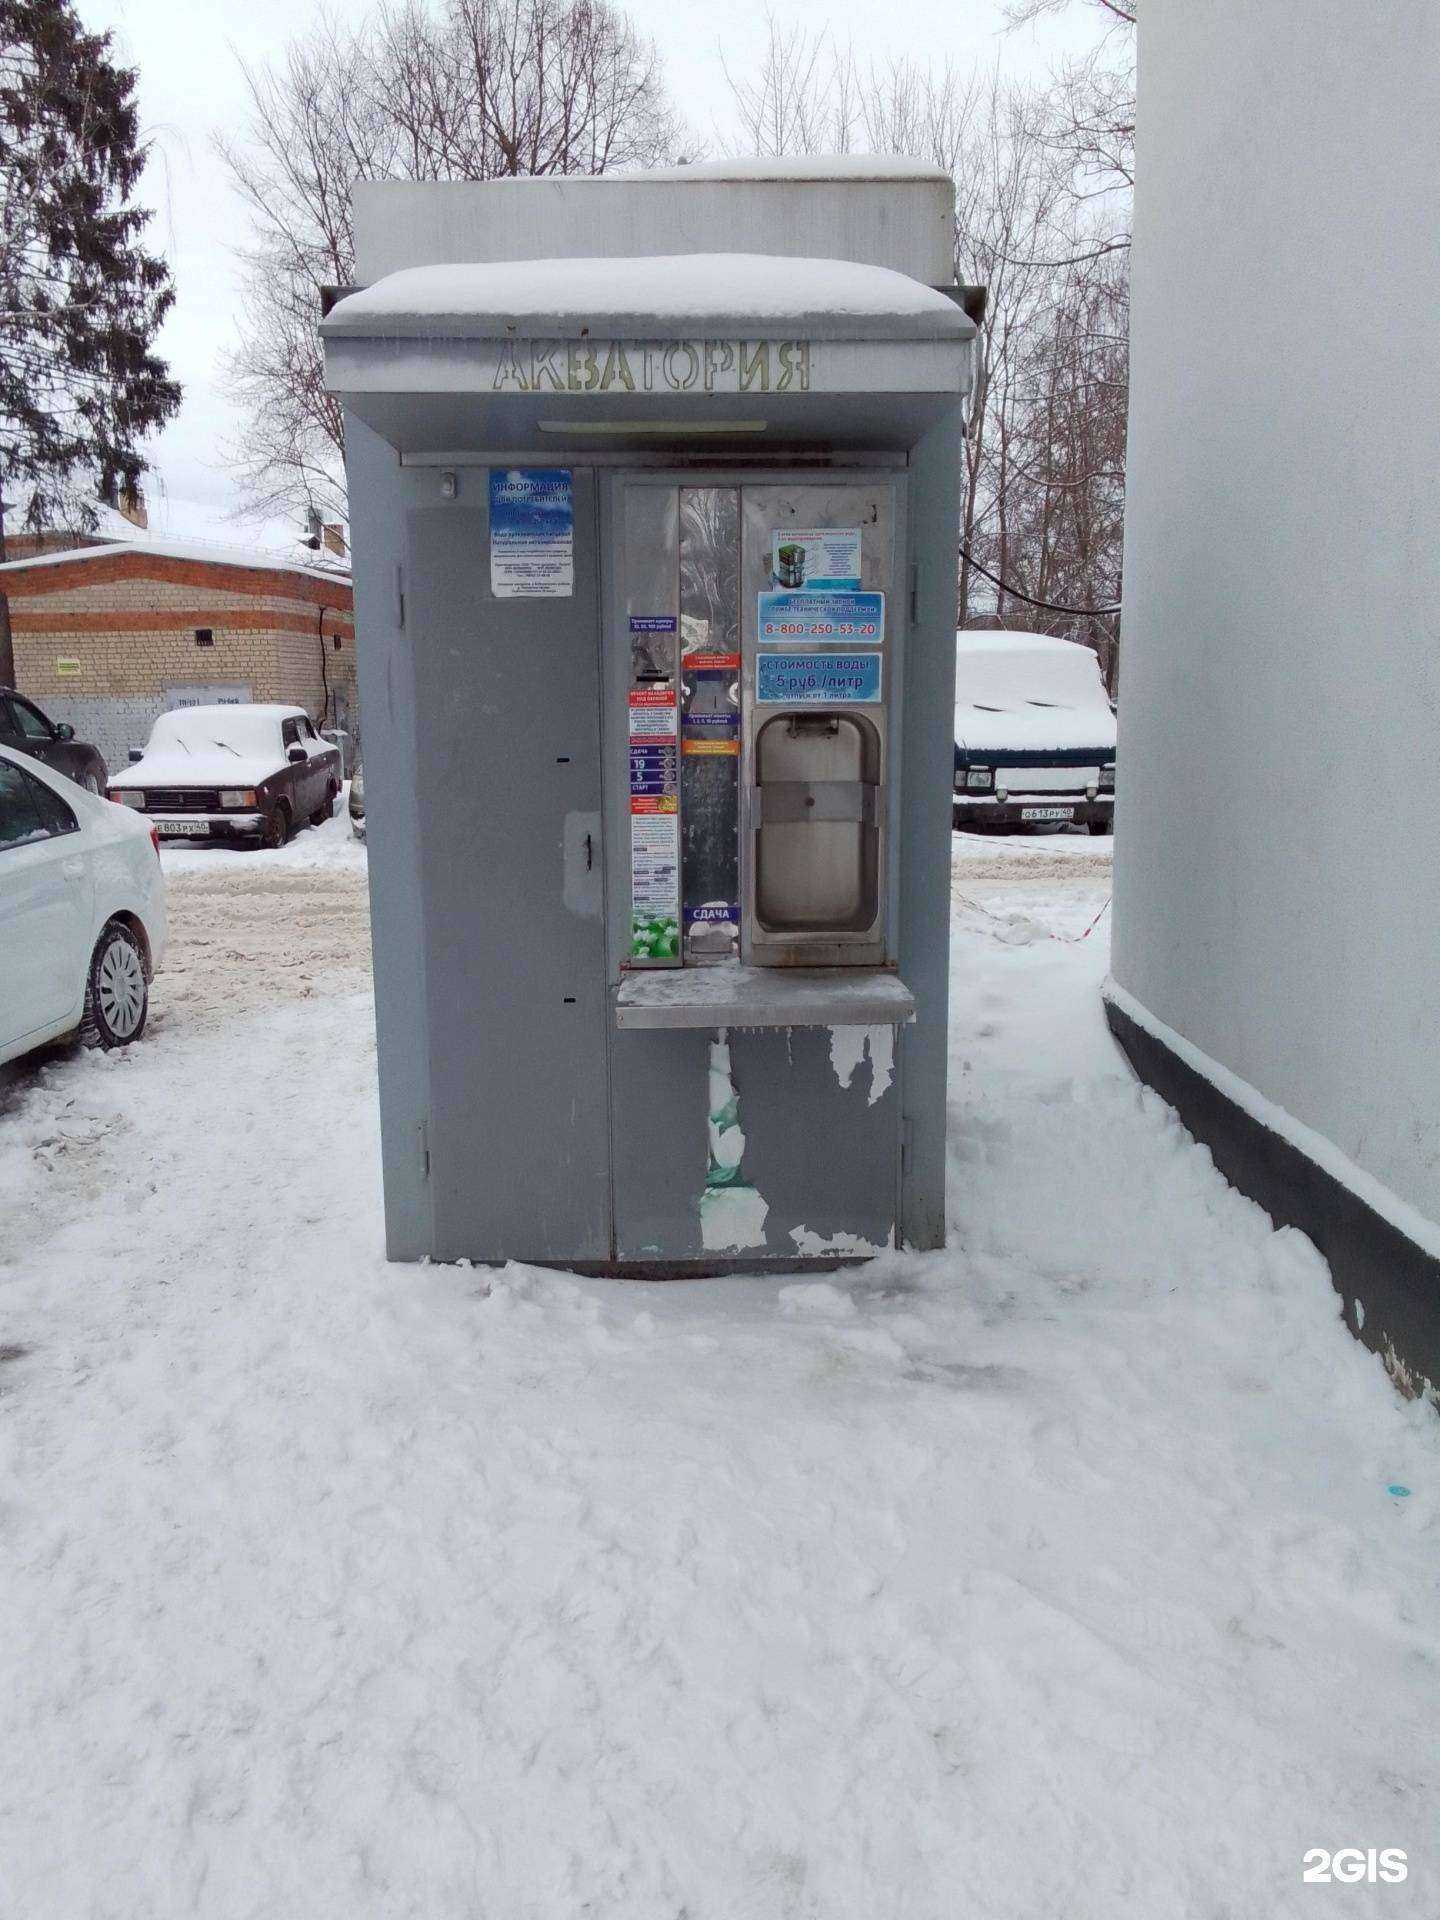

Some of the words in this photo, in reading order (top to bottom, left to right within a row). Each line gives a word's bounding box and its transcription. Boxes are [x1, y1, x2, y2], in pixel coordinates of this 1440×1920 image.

[493, 340, 810, 390] АКВАТОРИЯ
[493, 482, 568, 492] ИНФОРМАЦИЯ
[765, 623, 875, 635] 8-800-250-53-20
[767, 661, 833, 671] СТОИМОСТЬ
[776, 675, 786, 687] 5
[634, 759, 645, 769] 19
[636, 771, 643, 781] 5
[693, 909, 730, 919] СДАЧА
